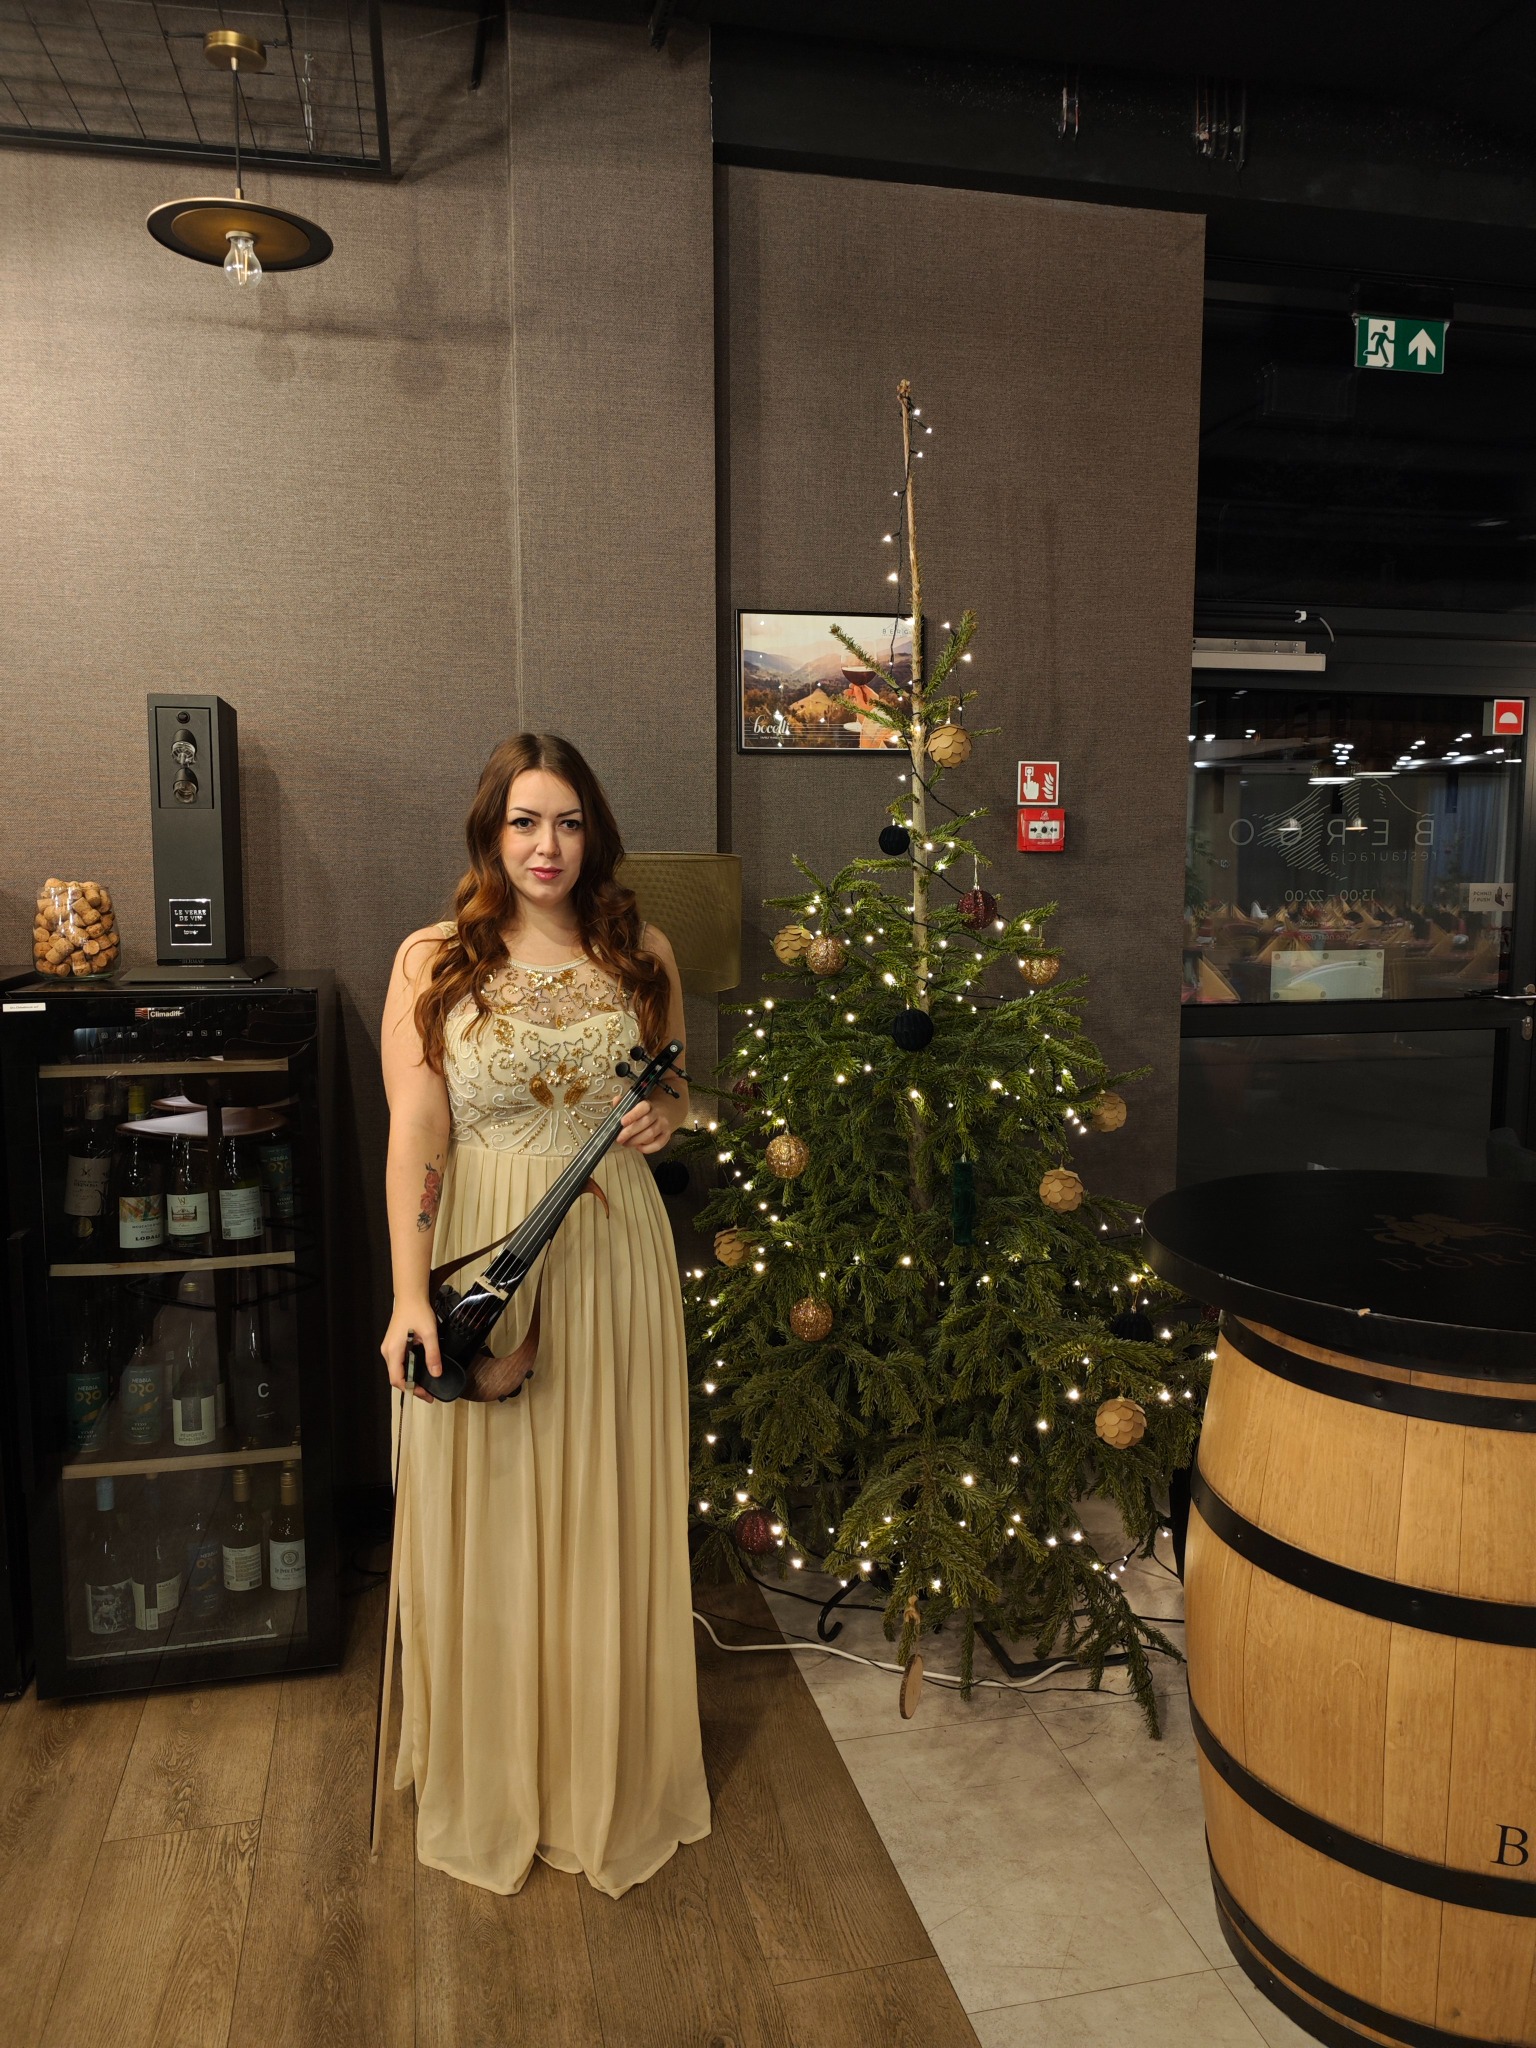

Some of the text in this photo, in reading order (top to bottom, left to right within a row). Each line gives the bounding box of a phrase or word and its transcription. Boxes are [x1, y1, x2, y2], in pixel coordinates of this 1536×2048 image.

[150, 1010, 182, 1018] Climadiff
[257, 1382, 270, 1398] C
[1490, 1823, 1529, 1867] B
